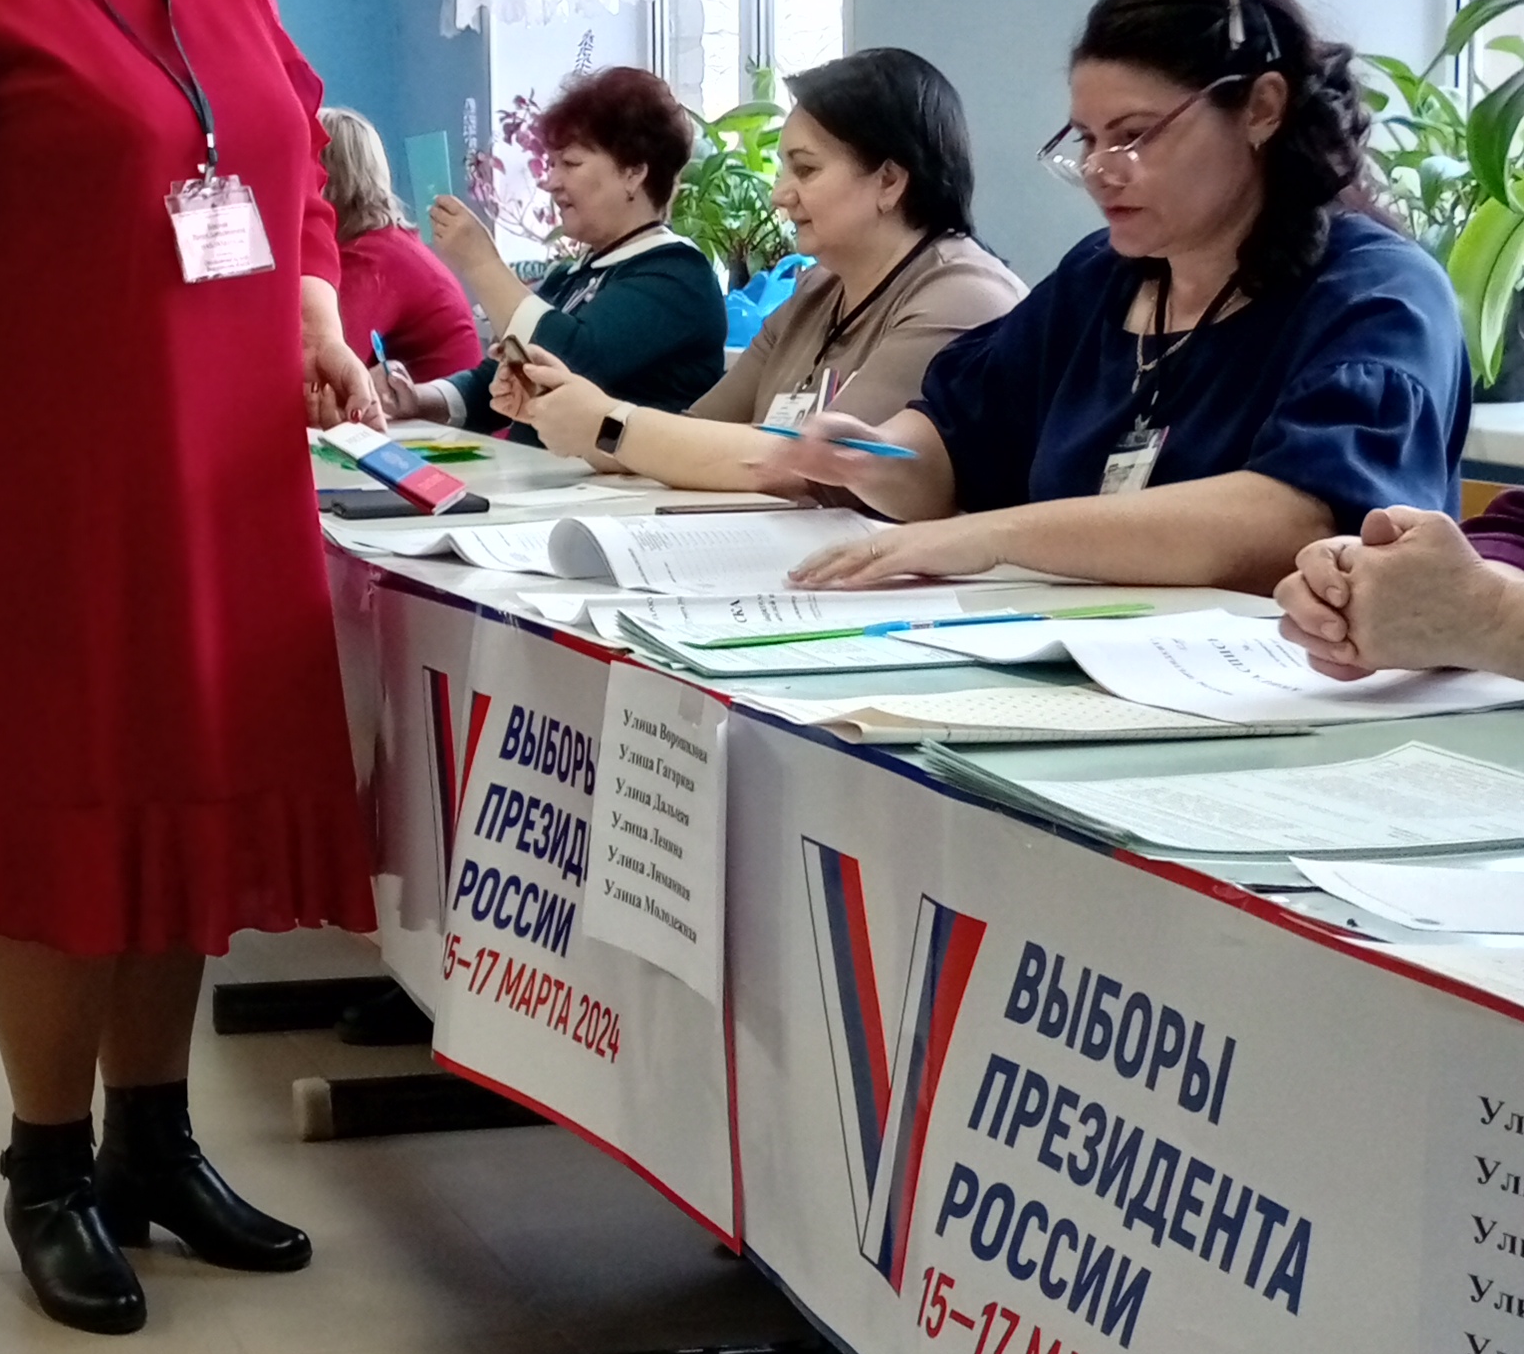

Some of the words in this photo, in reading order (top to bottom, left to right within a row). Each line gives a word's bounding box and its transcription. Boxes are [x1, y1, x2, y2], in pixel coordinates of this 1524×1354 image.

[623, 708, 657, 737] Улица
[619, 743, 654, 771] Улица
[615, 777, 651, 806] Улица
[474, 782, 592, 887] ПРЕЗИД
[611, 811, 648, 841] Улица
[650, 827, 683, 860] Ленина
[607, 845, 645, 875] Улица
[452, 858, 576, 959] РОССИИ
[604, 878, 642, 909] Улица
[495, 957, 573, 1036] МАРТА
[572, 994, 621, 1064] 2024
[1004, 940, 1236, 1126] ВЫБОРЫ
[1478, 1096, 1524, 1135] Ул
[966, 1053, 1313, 1317] ПРЕЗИДЕНТА
[1475, 1155, 1524, 1195] Ул
[935, 1162, 1153, 1350] РОССИИ
[1467, 1273, 1524, 1318] Ули
